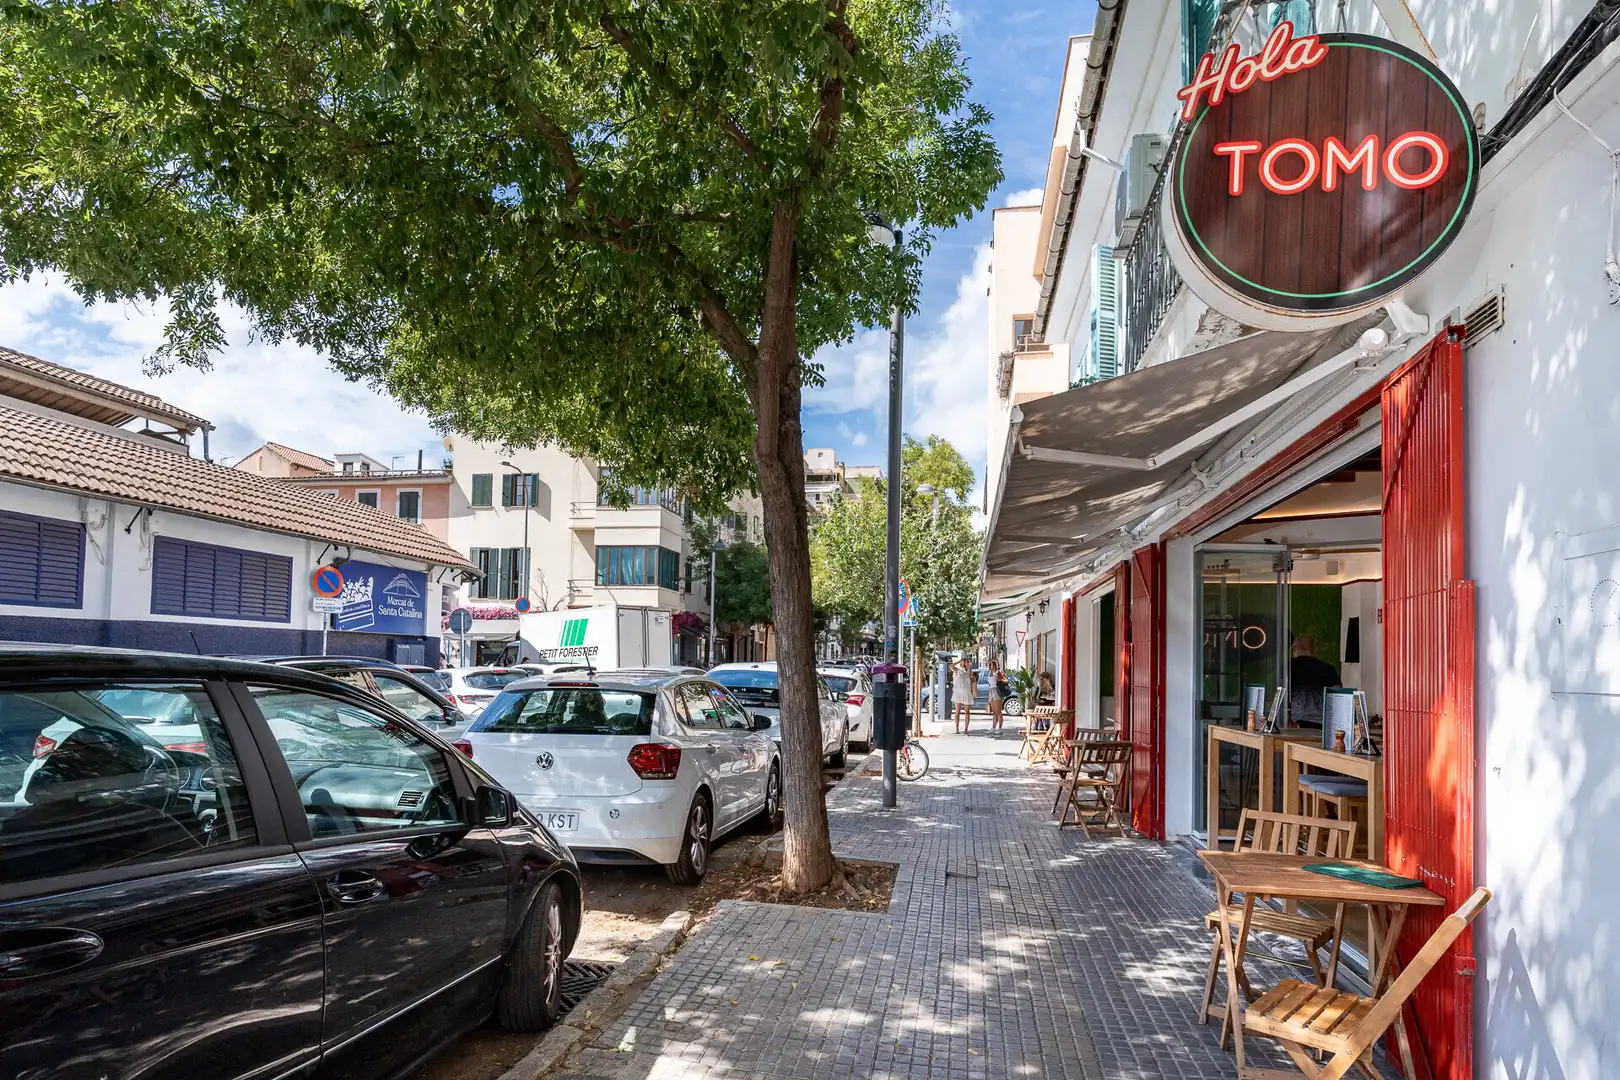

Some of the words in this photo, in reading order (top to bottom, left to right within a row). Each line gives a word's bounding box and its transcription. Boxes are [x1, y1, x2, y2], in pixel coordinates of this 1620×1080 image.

[1177, 20, 1329, 121] Hola
[1213, 131, 1449, 196] TOMO
[387, 596, 406, 606] Mercat
[407, 598, 414, 607] de
[378, 605, 397, 616] Santa
[398, 607, 422, 618] Catalina
[539, 648, 558, 659] PETIT
[559, 646, 598, 657] FORESTIER
[547, 813, 575, 829] KST
